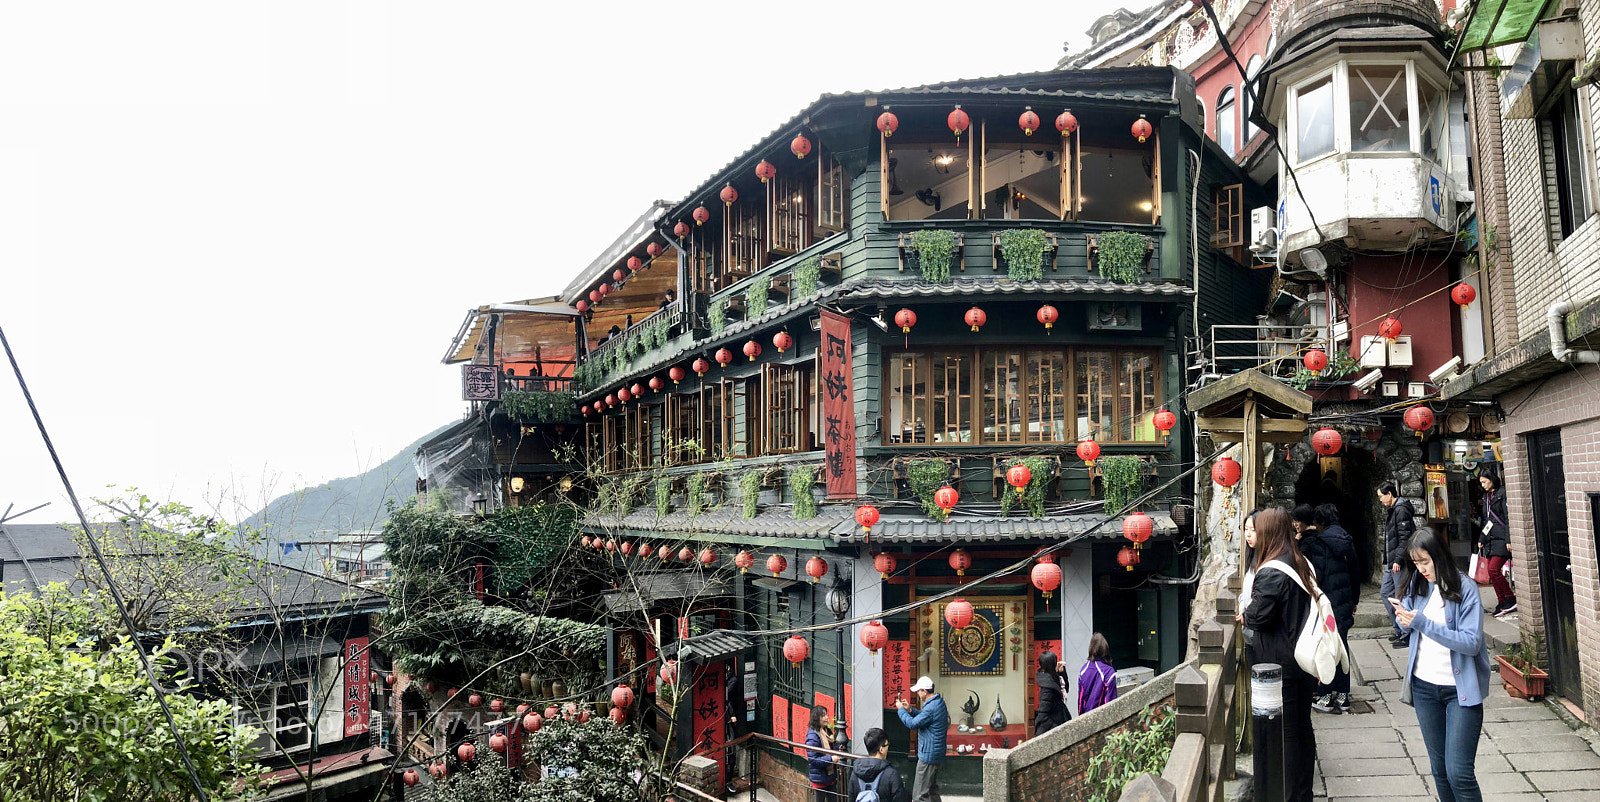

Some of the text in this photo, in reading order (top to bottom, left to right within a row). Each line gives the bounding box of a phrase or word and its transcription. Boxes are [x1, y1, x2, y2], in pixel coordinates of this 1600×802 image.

[823, 332, 848, 478] 阿妹茶樓
[347, 643, 361, 722] 悲情城市
[694, 671, 720, 761] 阿妹茶
